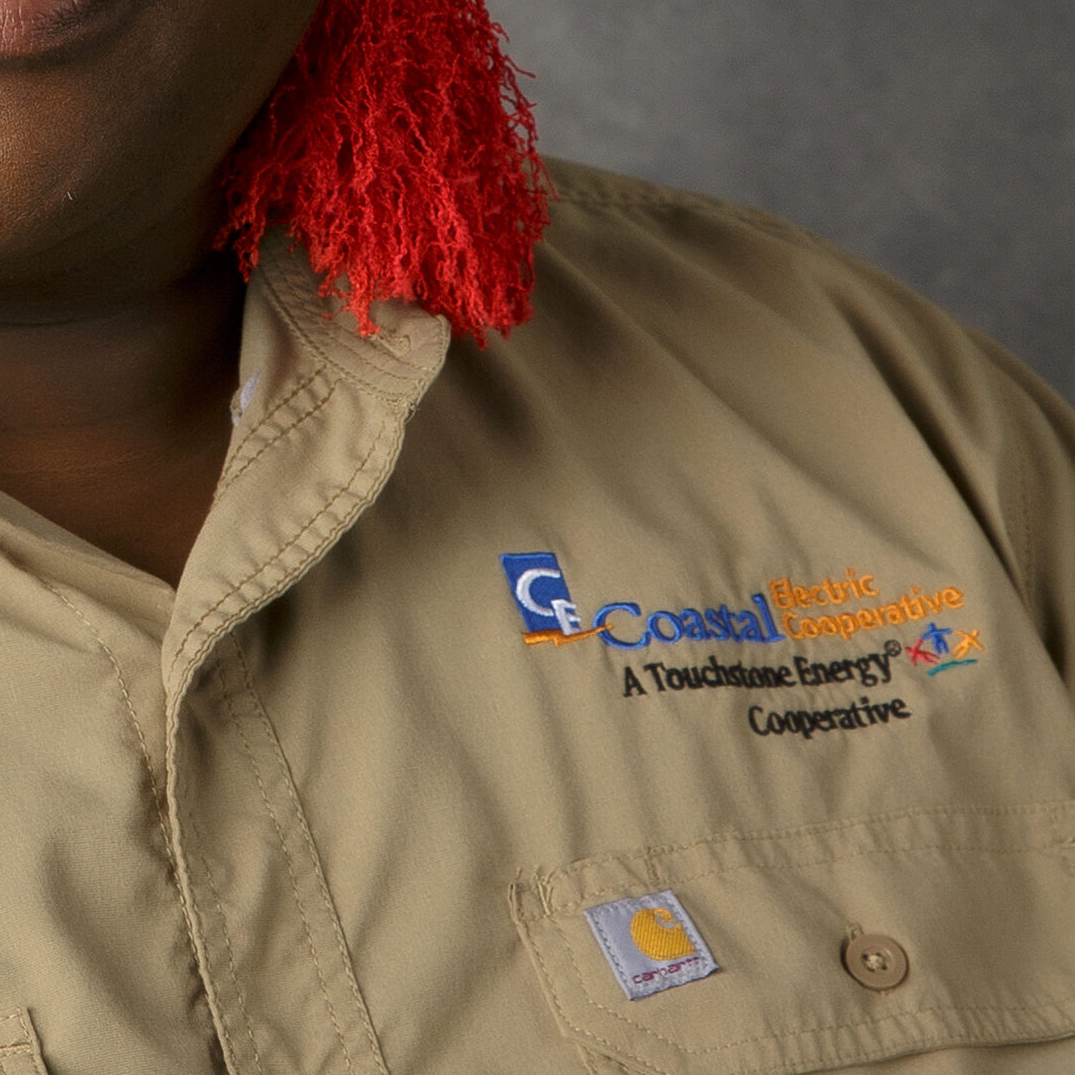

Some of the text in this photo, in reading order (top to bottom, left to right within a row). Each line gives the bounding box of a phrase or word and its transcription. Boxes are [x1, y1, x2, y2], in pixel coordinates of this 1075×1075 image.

[769, 568, 878, 609] Electric
[593, 593, 785, 649] Coastal
[782, 587, 964, 640] Cooperative
[623, 666, 648, 698] A
[643, 655, 797, 692] Touchstone
[748, 696, 912, 740] Cooperative
